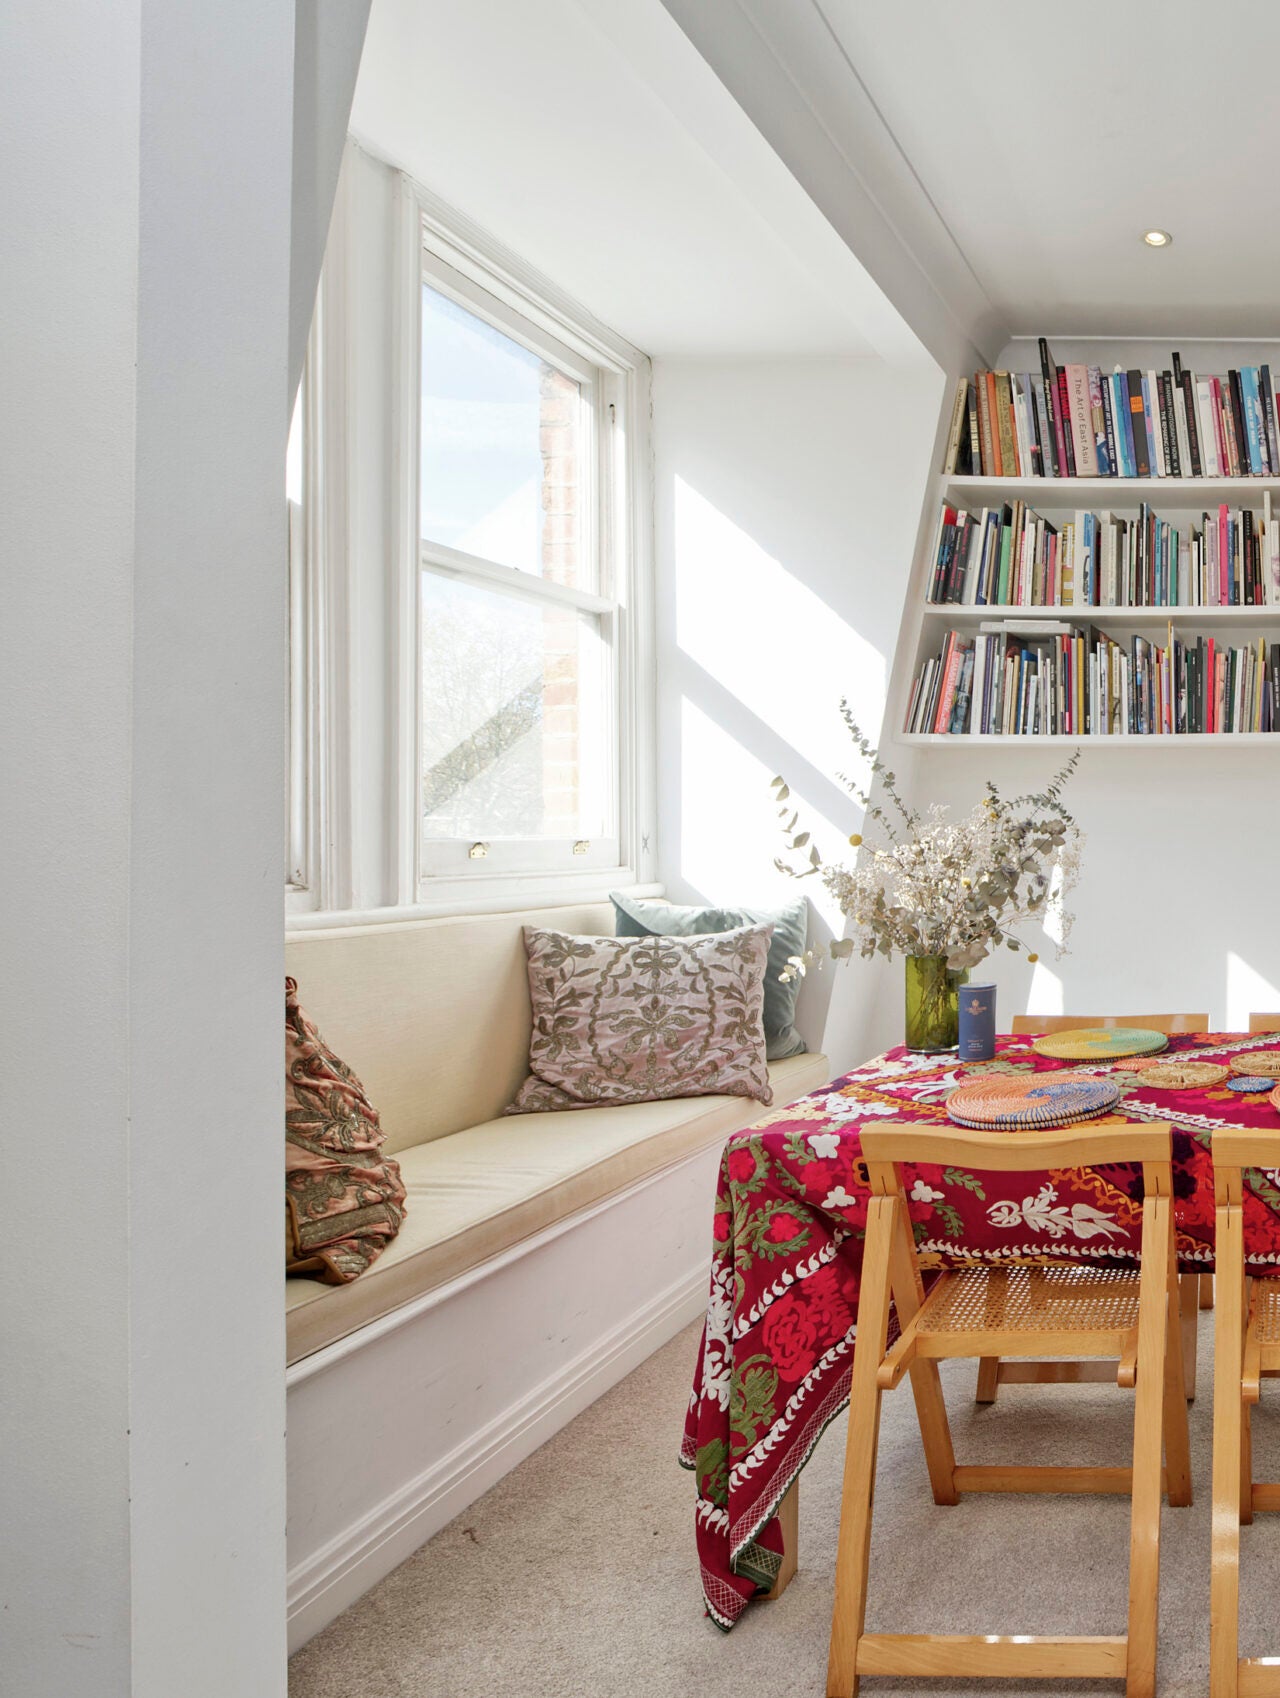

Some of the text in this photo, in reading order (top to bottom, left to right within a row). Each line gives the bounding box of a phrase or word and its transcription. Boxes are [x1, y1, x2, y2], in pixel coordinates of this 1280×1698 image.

[1059, 389, 1070, 420] LEVANT
[1102, 379, 1110, 412] CONTEMPORARY
[1165, 383, 1173, 406] IRANIAN
[1075, 379, 1083, 394] The
[1081, 445, 1089, 464] Asia
[1167, 407, 1176, 446] PHOTOGRAPHY
